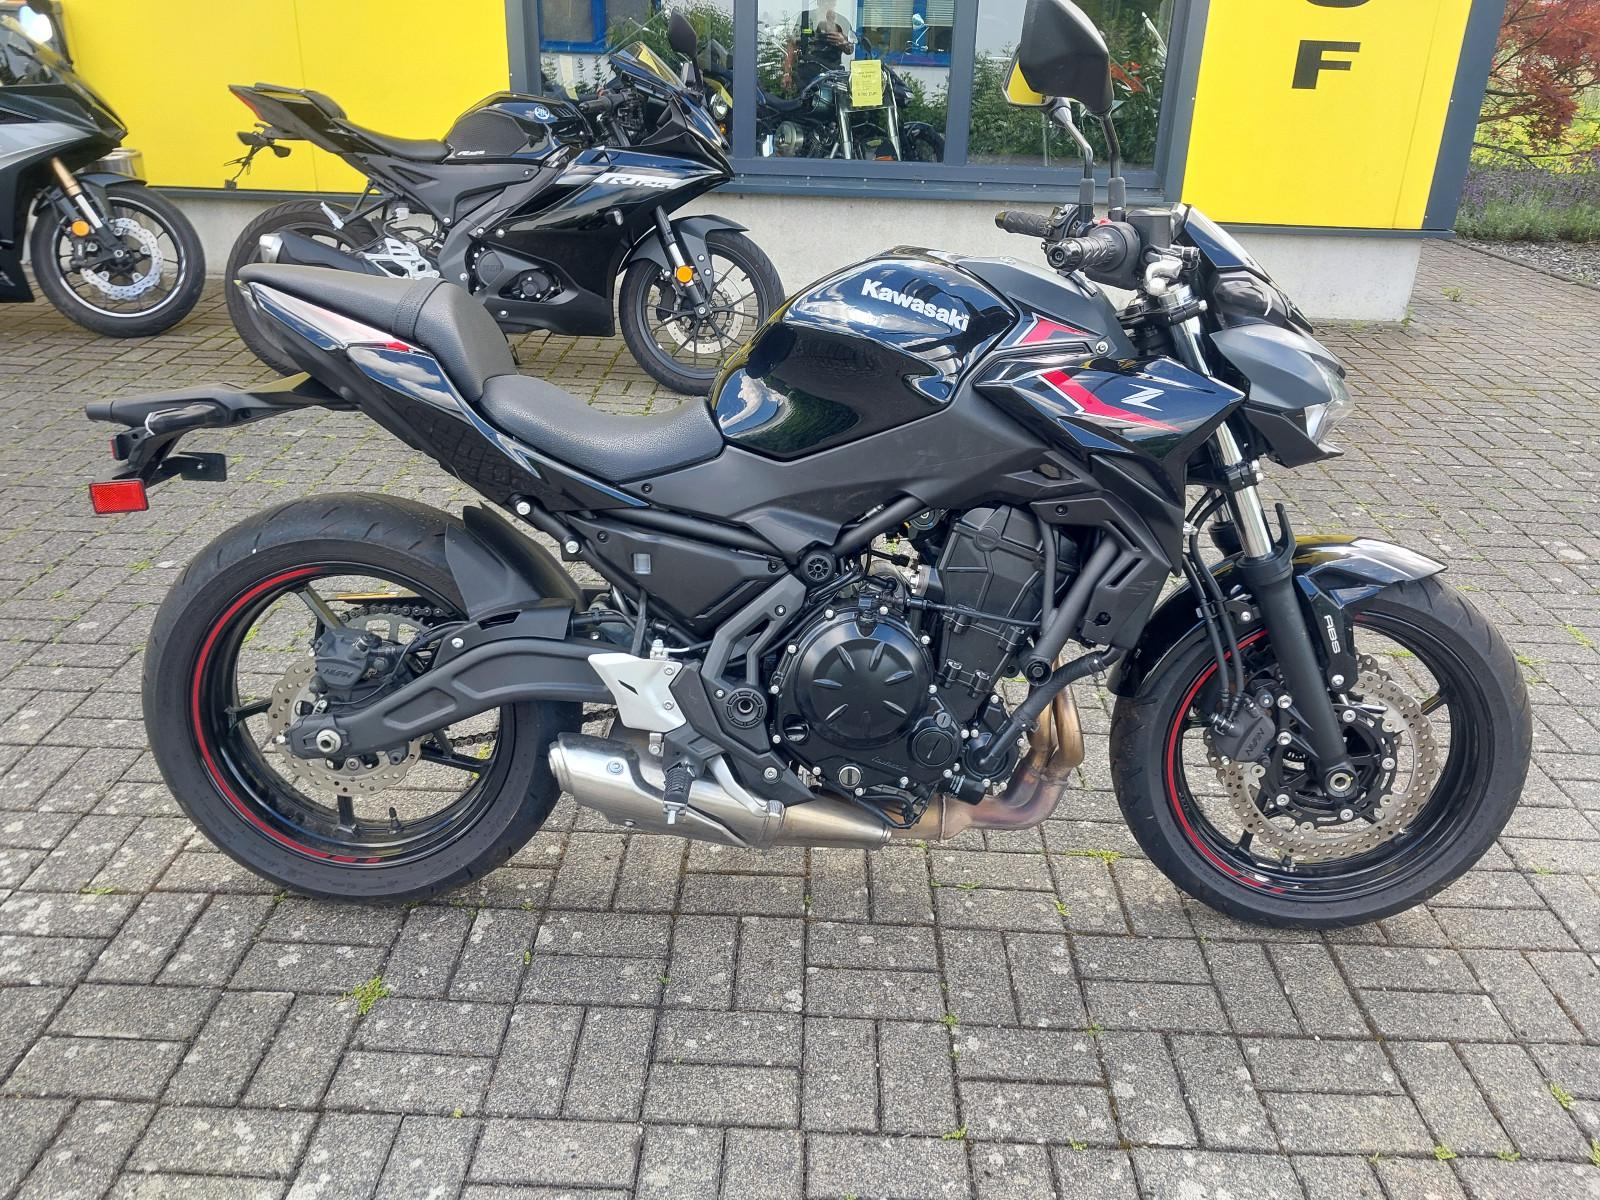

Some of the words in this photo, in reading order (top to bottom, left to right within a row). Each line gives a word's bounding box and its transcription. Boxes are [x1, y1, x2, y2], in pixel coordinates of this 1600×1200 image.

[861, 279, 970, 332] Kawasaki
[1121, 383, 1165, 412] Z
[1323, 614, 1341, 654] ABS
